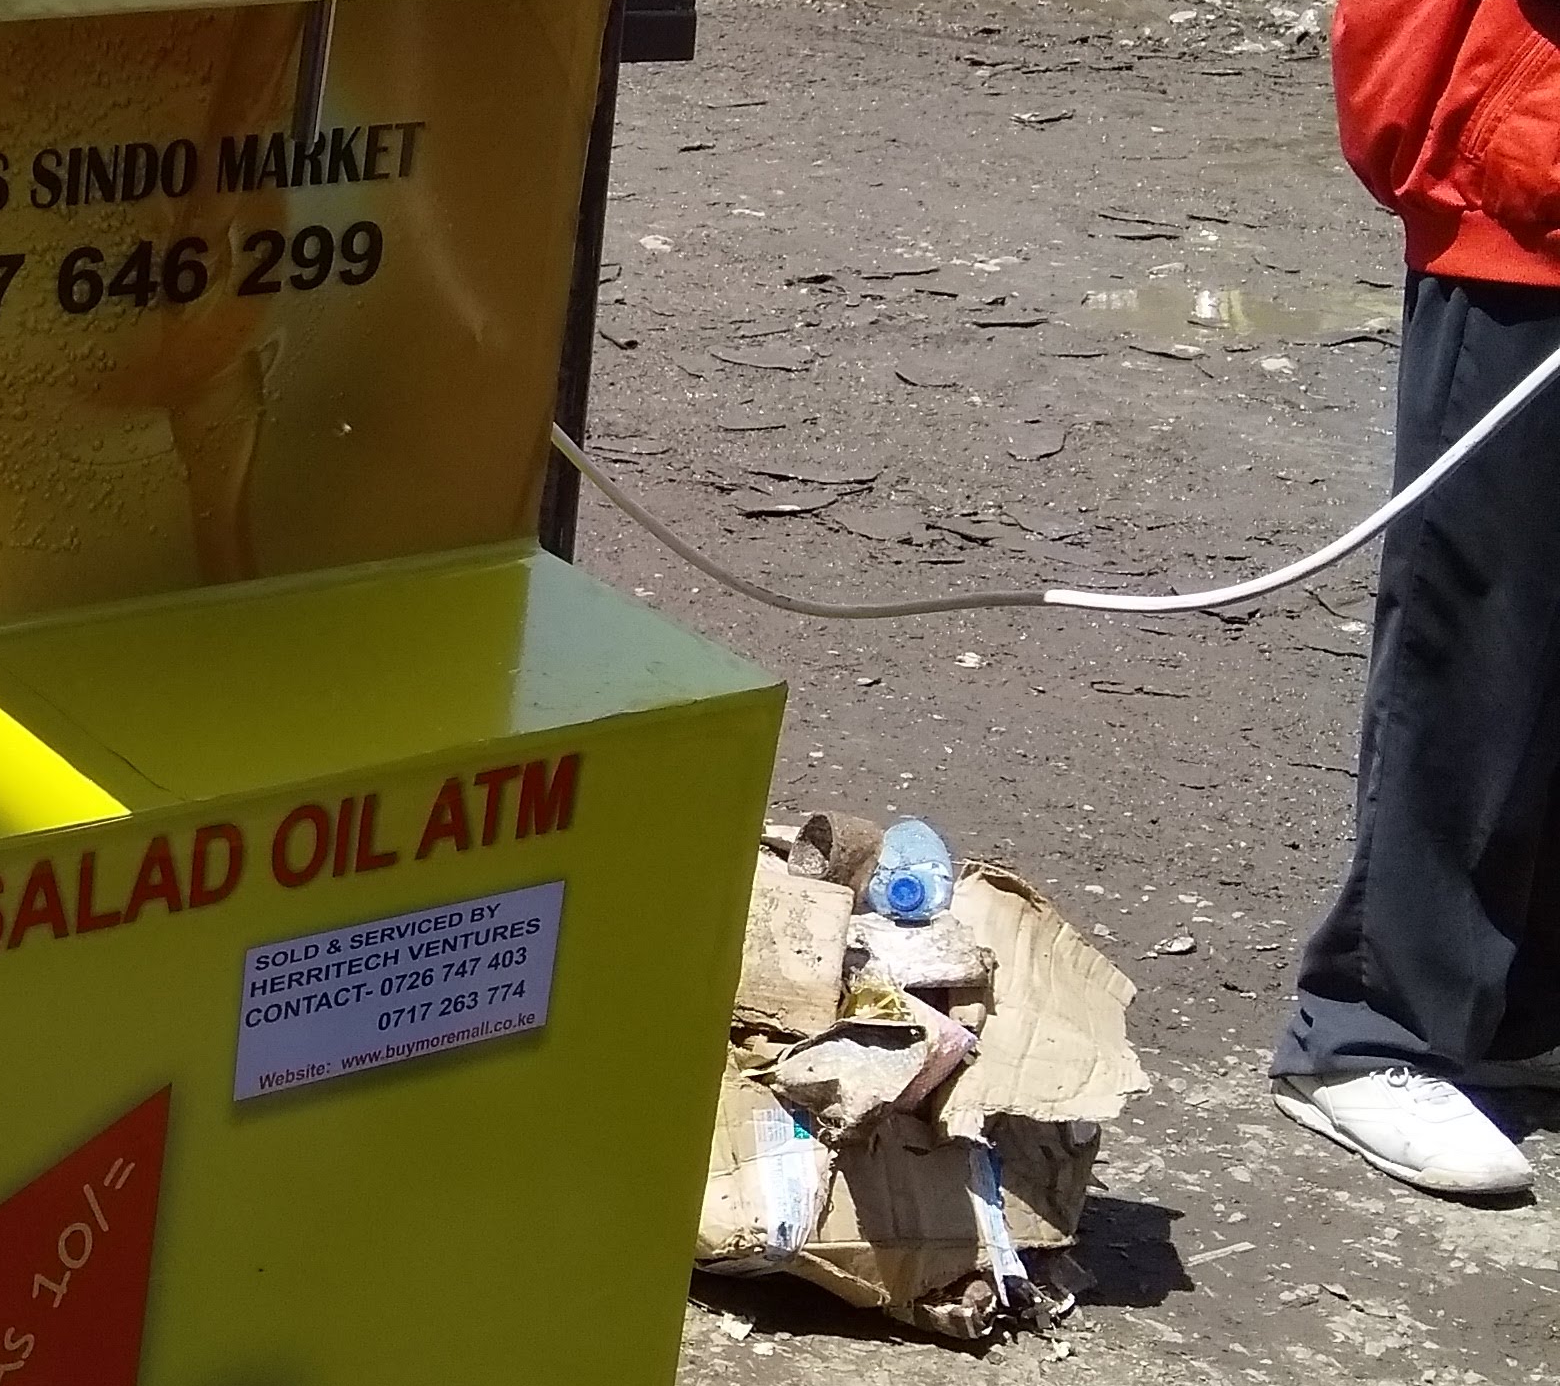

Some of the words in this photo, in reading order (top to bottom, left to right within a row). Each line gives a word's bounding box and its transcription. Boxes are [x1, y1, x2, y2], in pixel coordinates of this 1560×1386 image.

[29, 138, 198, 210] SINDO
[215, 121, 424, 192] MARKET
[56, 235, 210, 316] 646
[236, 219, 385, 298] 299
[270, 792, 399, 890] OIL
[414, 752, 582, 862] ATM
[249, 948, 400, 999] HERRITECH
[407, 916, 542, 962] VENTURES
[254, 943, 320, 972] SOLD
[325, 938, 343, 955] &
[349, 911, 464, 951] SERVICED
[469, 902, 502, 924] BY
[244, 982, 374, 1029] CONTACT-
[379, 967, 435, 998] 0726
[442, 956, 482, 984] 747
[488, 946, 528, 972] 403
[377, 1001, 433, 1032] 0717
[438, 991, 479, 1018] 263
[486, 979, 527, 1006] 774
[258, 1062, 332, 1091] Website:
[340, 1010, 537, 1072] www.buymoremall.co.ke
[32, 1157, 136, 1308] 10/=
